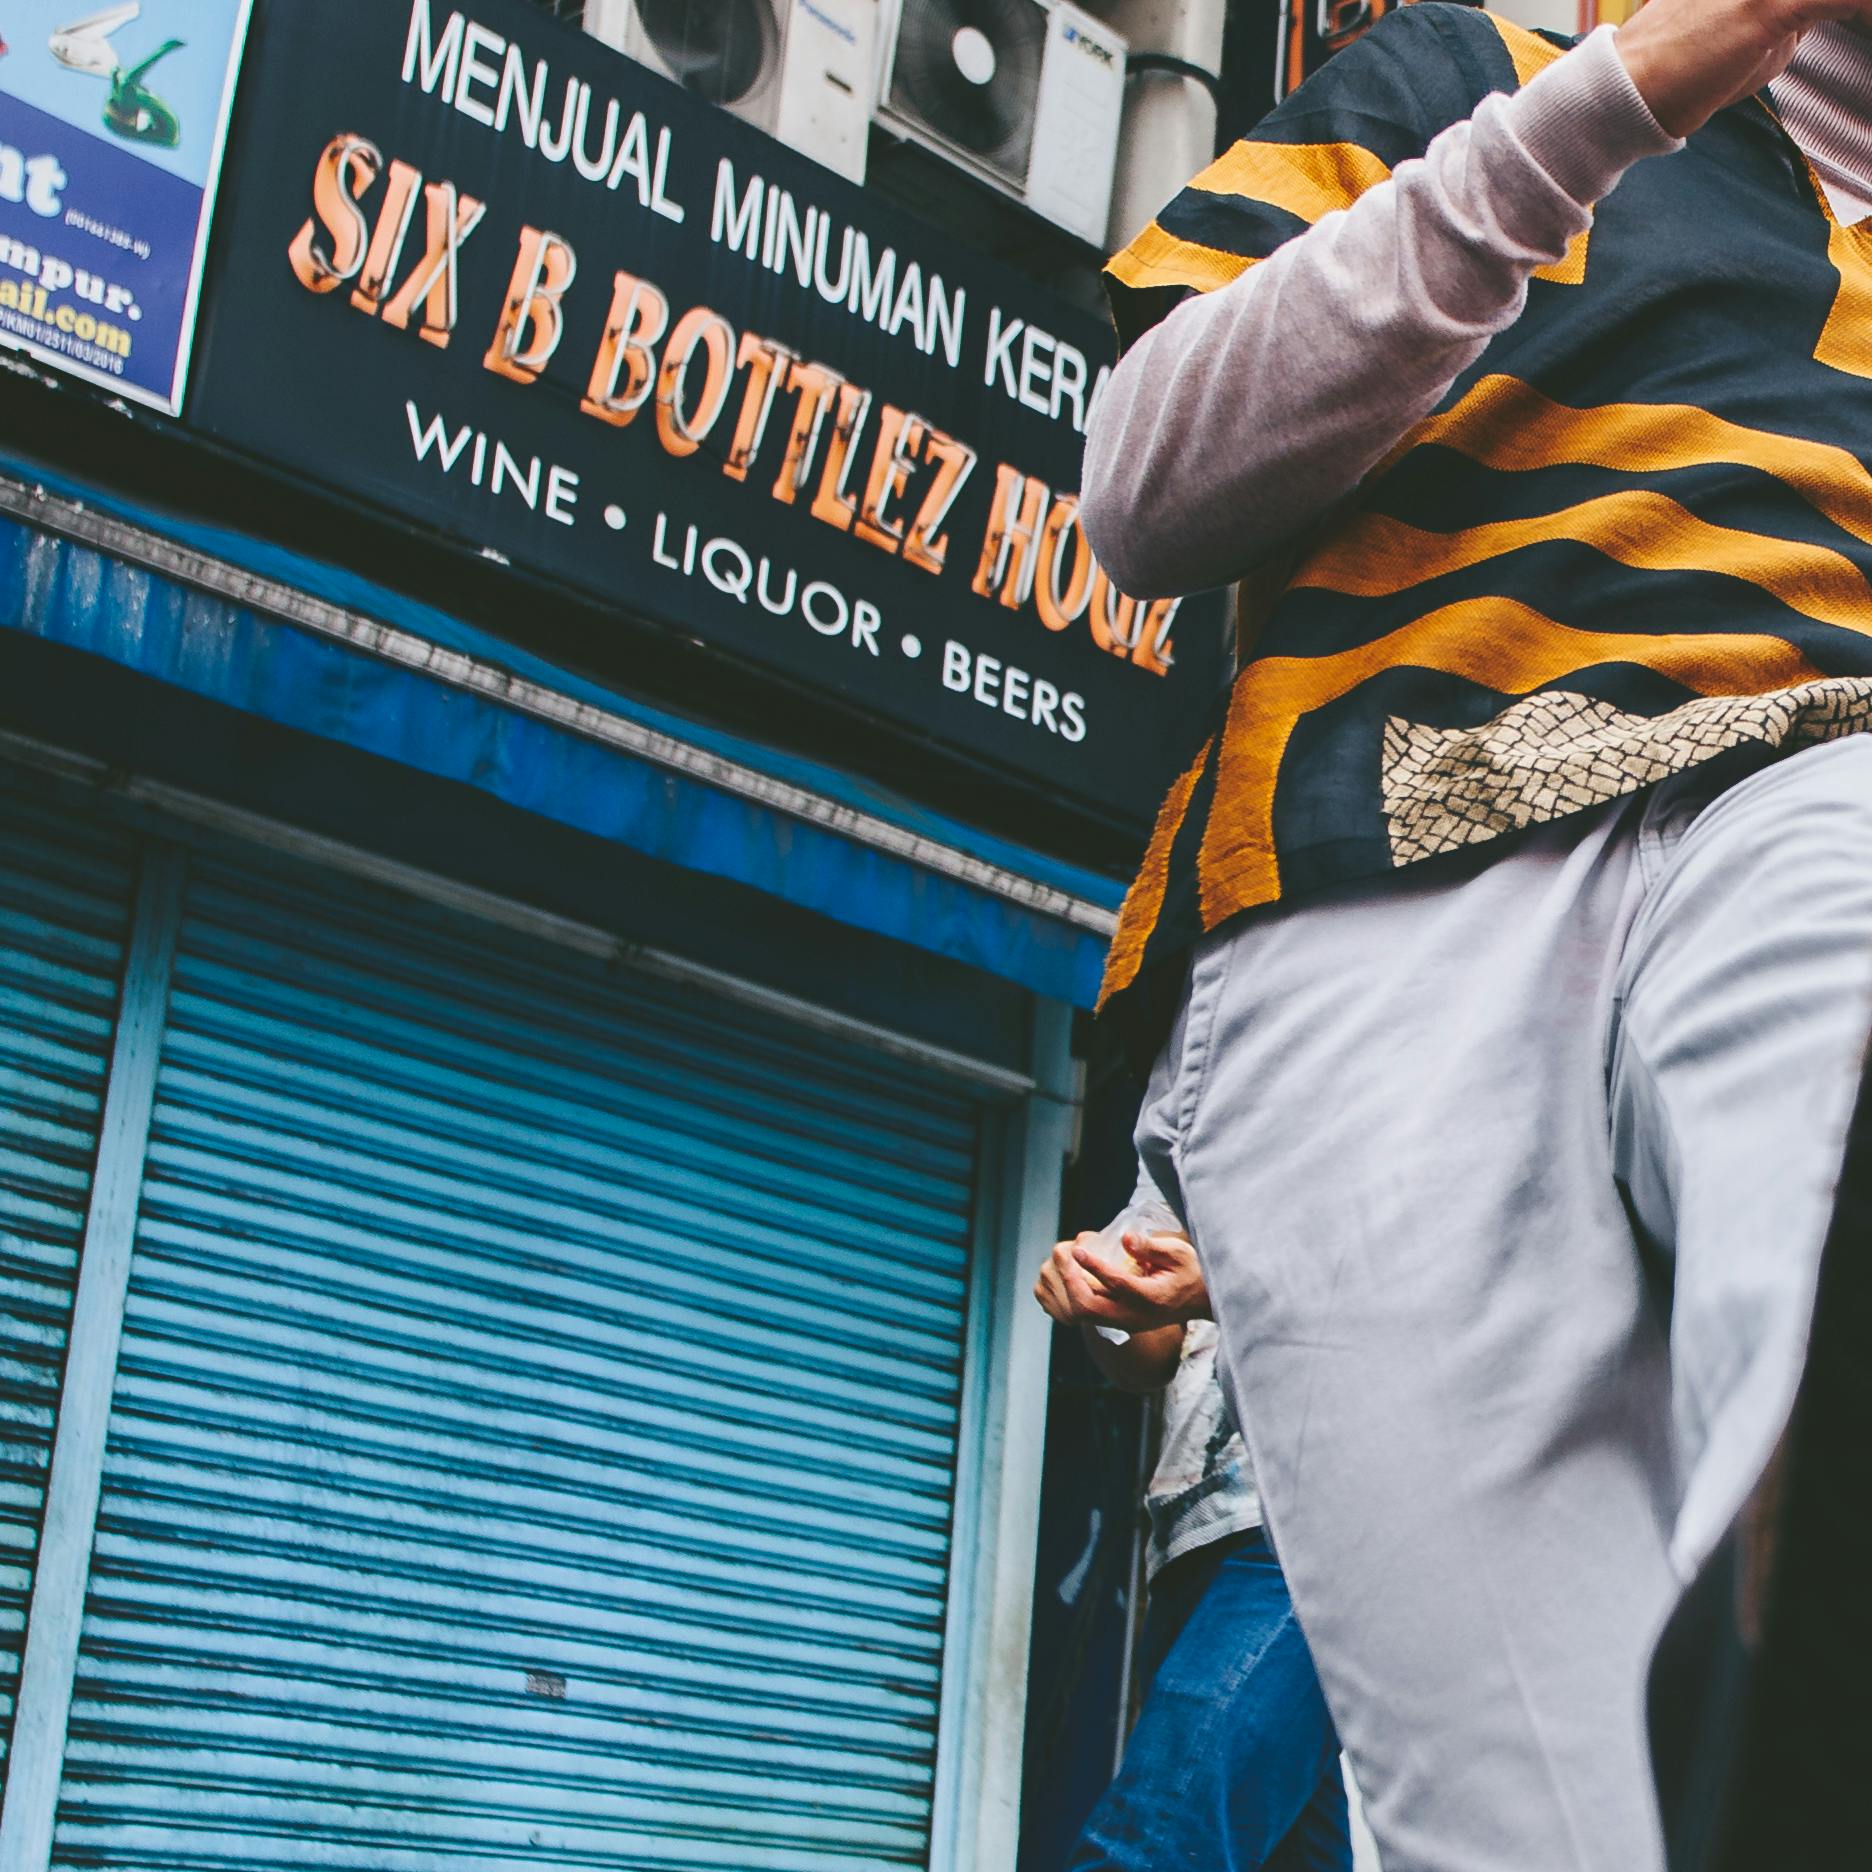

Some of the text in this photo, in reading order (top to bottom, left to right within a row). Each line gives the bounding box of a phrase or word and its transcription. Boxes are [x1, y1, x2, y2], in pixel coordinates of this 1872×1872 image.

[288, 133, 487, 350] SIX
[483, 224, 578, 386] B
[580, 270, 978, 577] BOTTLEZ
[710, 157, 968, 369] MINUMAN
[983, 305, 1112, 435] KER
[405, 400, 1088, 745] WINE LIQUOR BEERS
